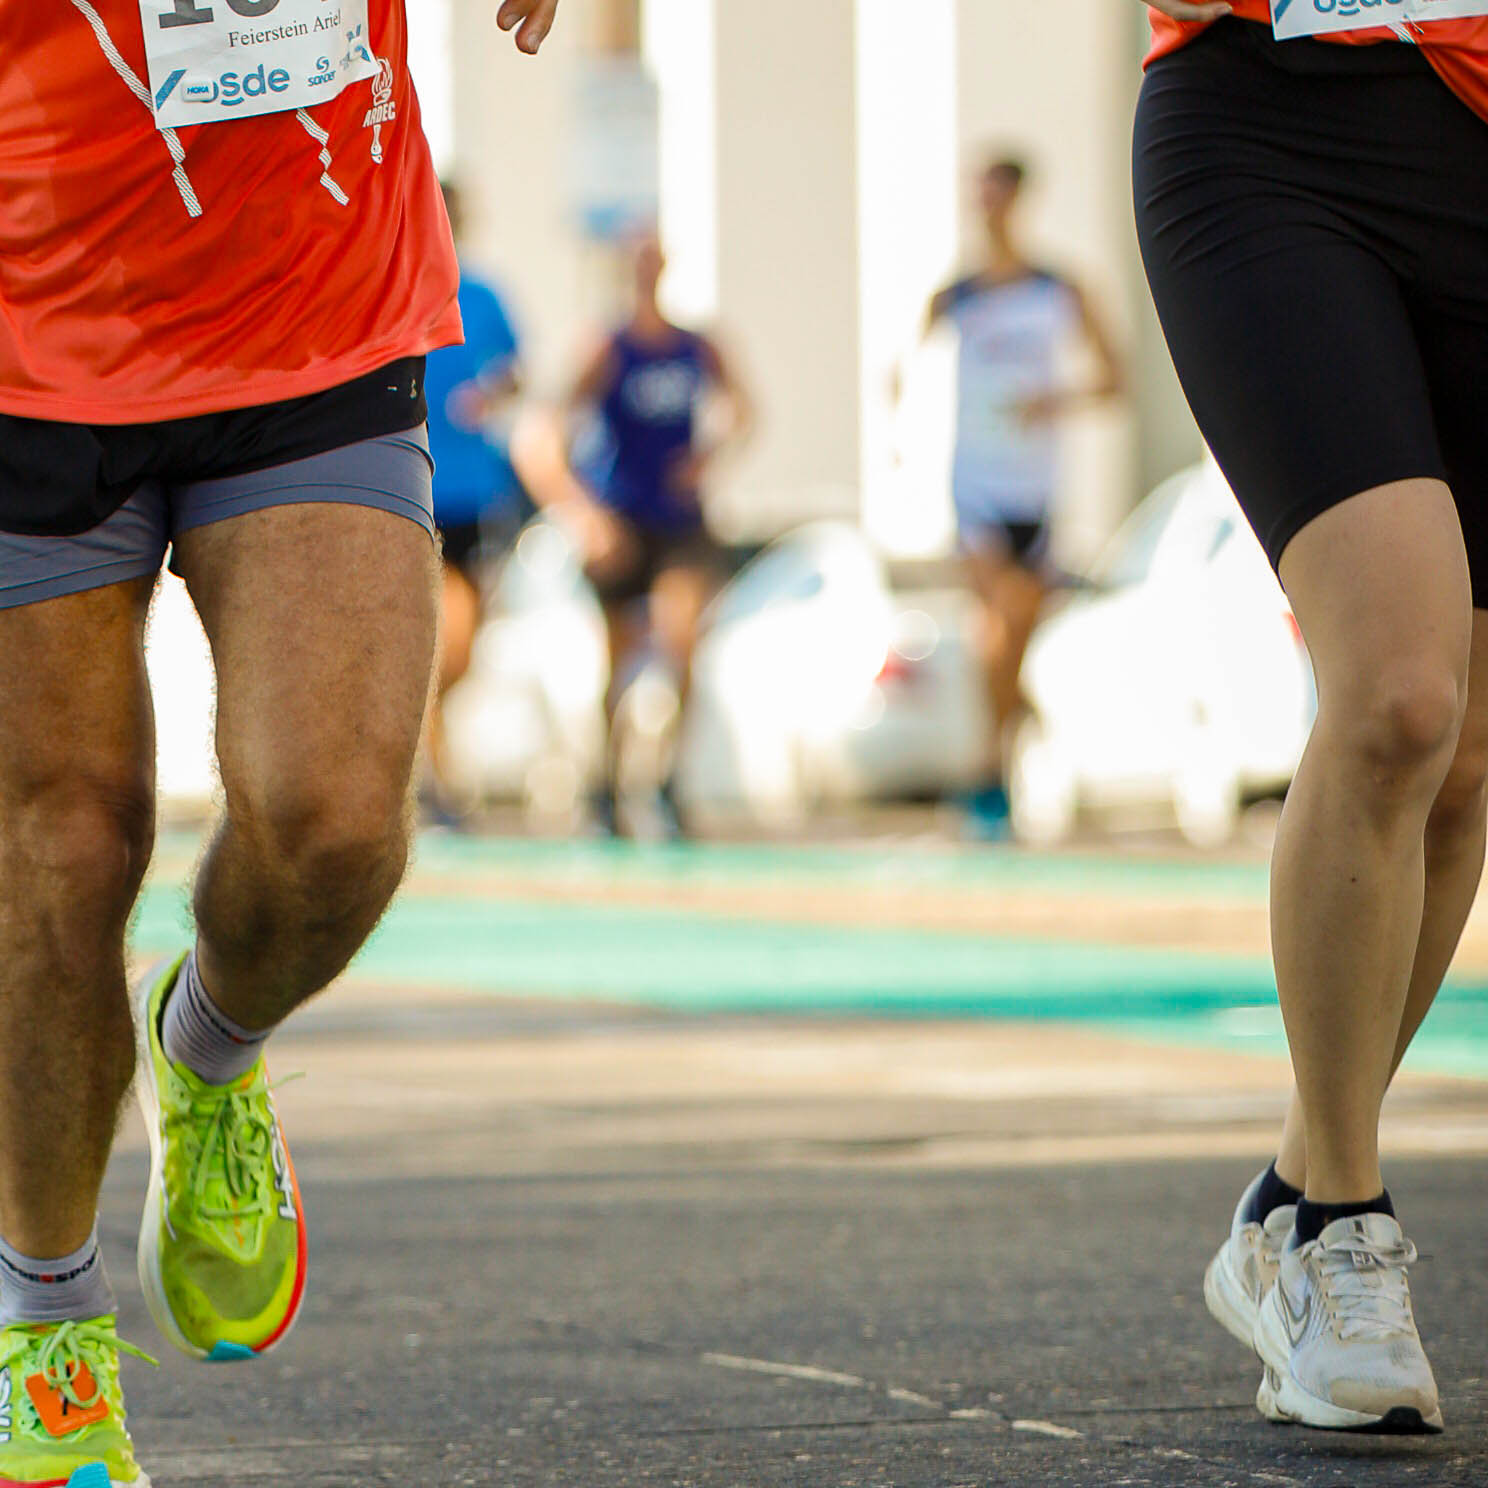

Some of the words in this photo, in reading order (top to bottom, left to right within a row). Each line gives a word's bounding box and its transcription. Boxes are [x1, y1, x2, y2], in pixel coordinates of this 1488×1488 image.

[228, 20, 308, 48] Feierstein
[313, 8, 341, 32] Ariel
[363, 101, 396, 128] ARDEC
